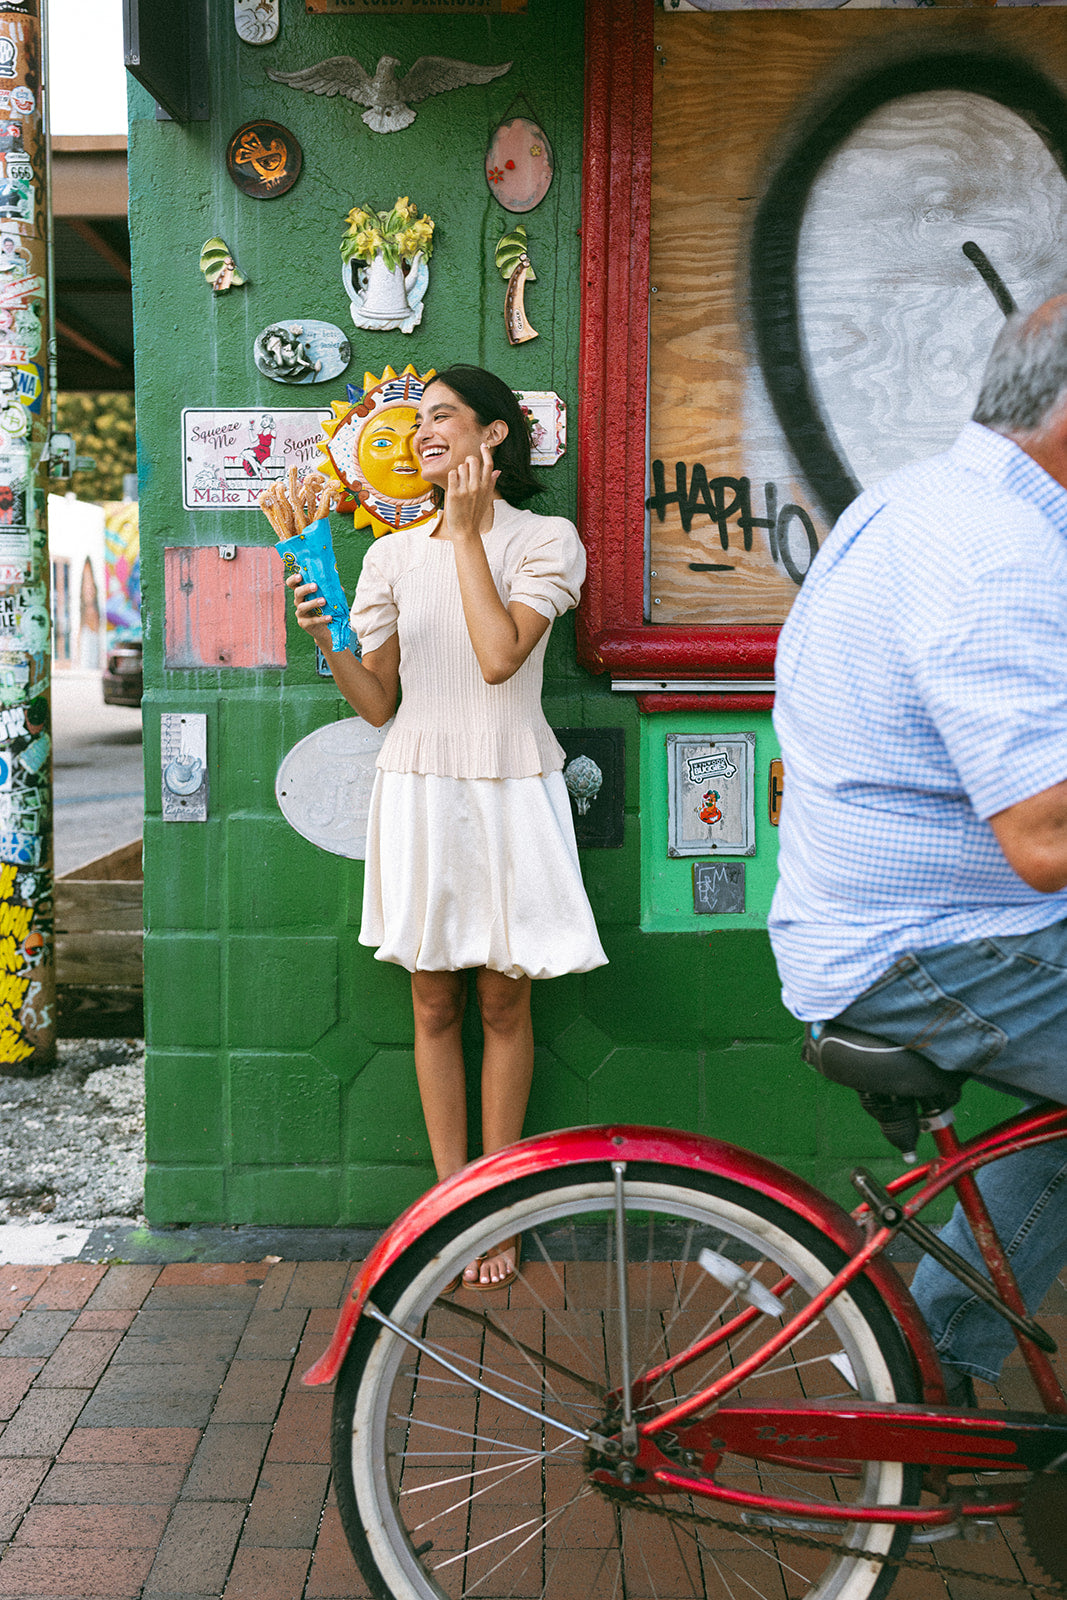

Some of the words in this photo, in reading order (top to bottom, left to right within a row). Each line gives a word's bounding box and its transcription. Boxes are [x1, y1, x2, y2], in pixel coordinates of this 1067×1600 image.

[11, 166, 31, 180] 666
[191, 422, 242, 444] Squeeze
[208, 434, 236, 450] Me
[283, 433, 323, 455] Stomp
[295, 446, 323, 463] Me
[194, 488, 240, 503] Make
[752, 1426, 838, 1445] Dyno
